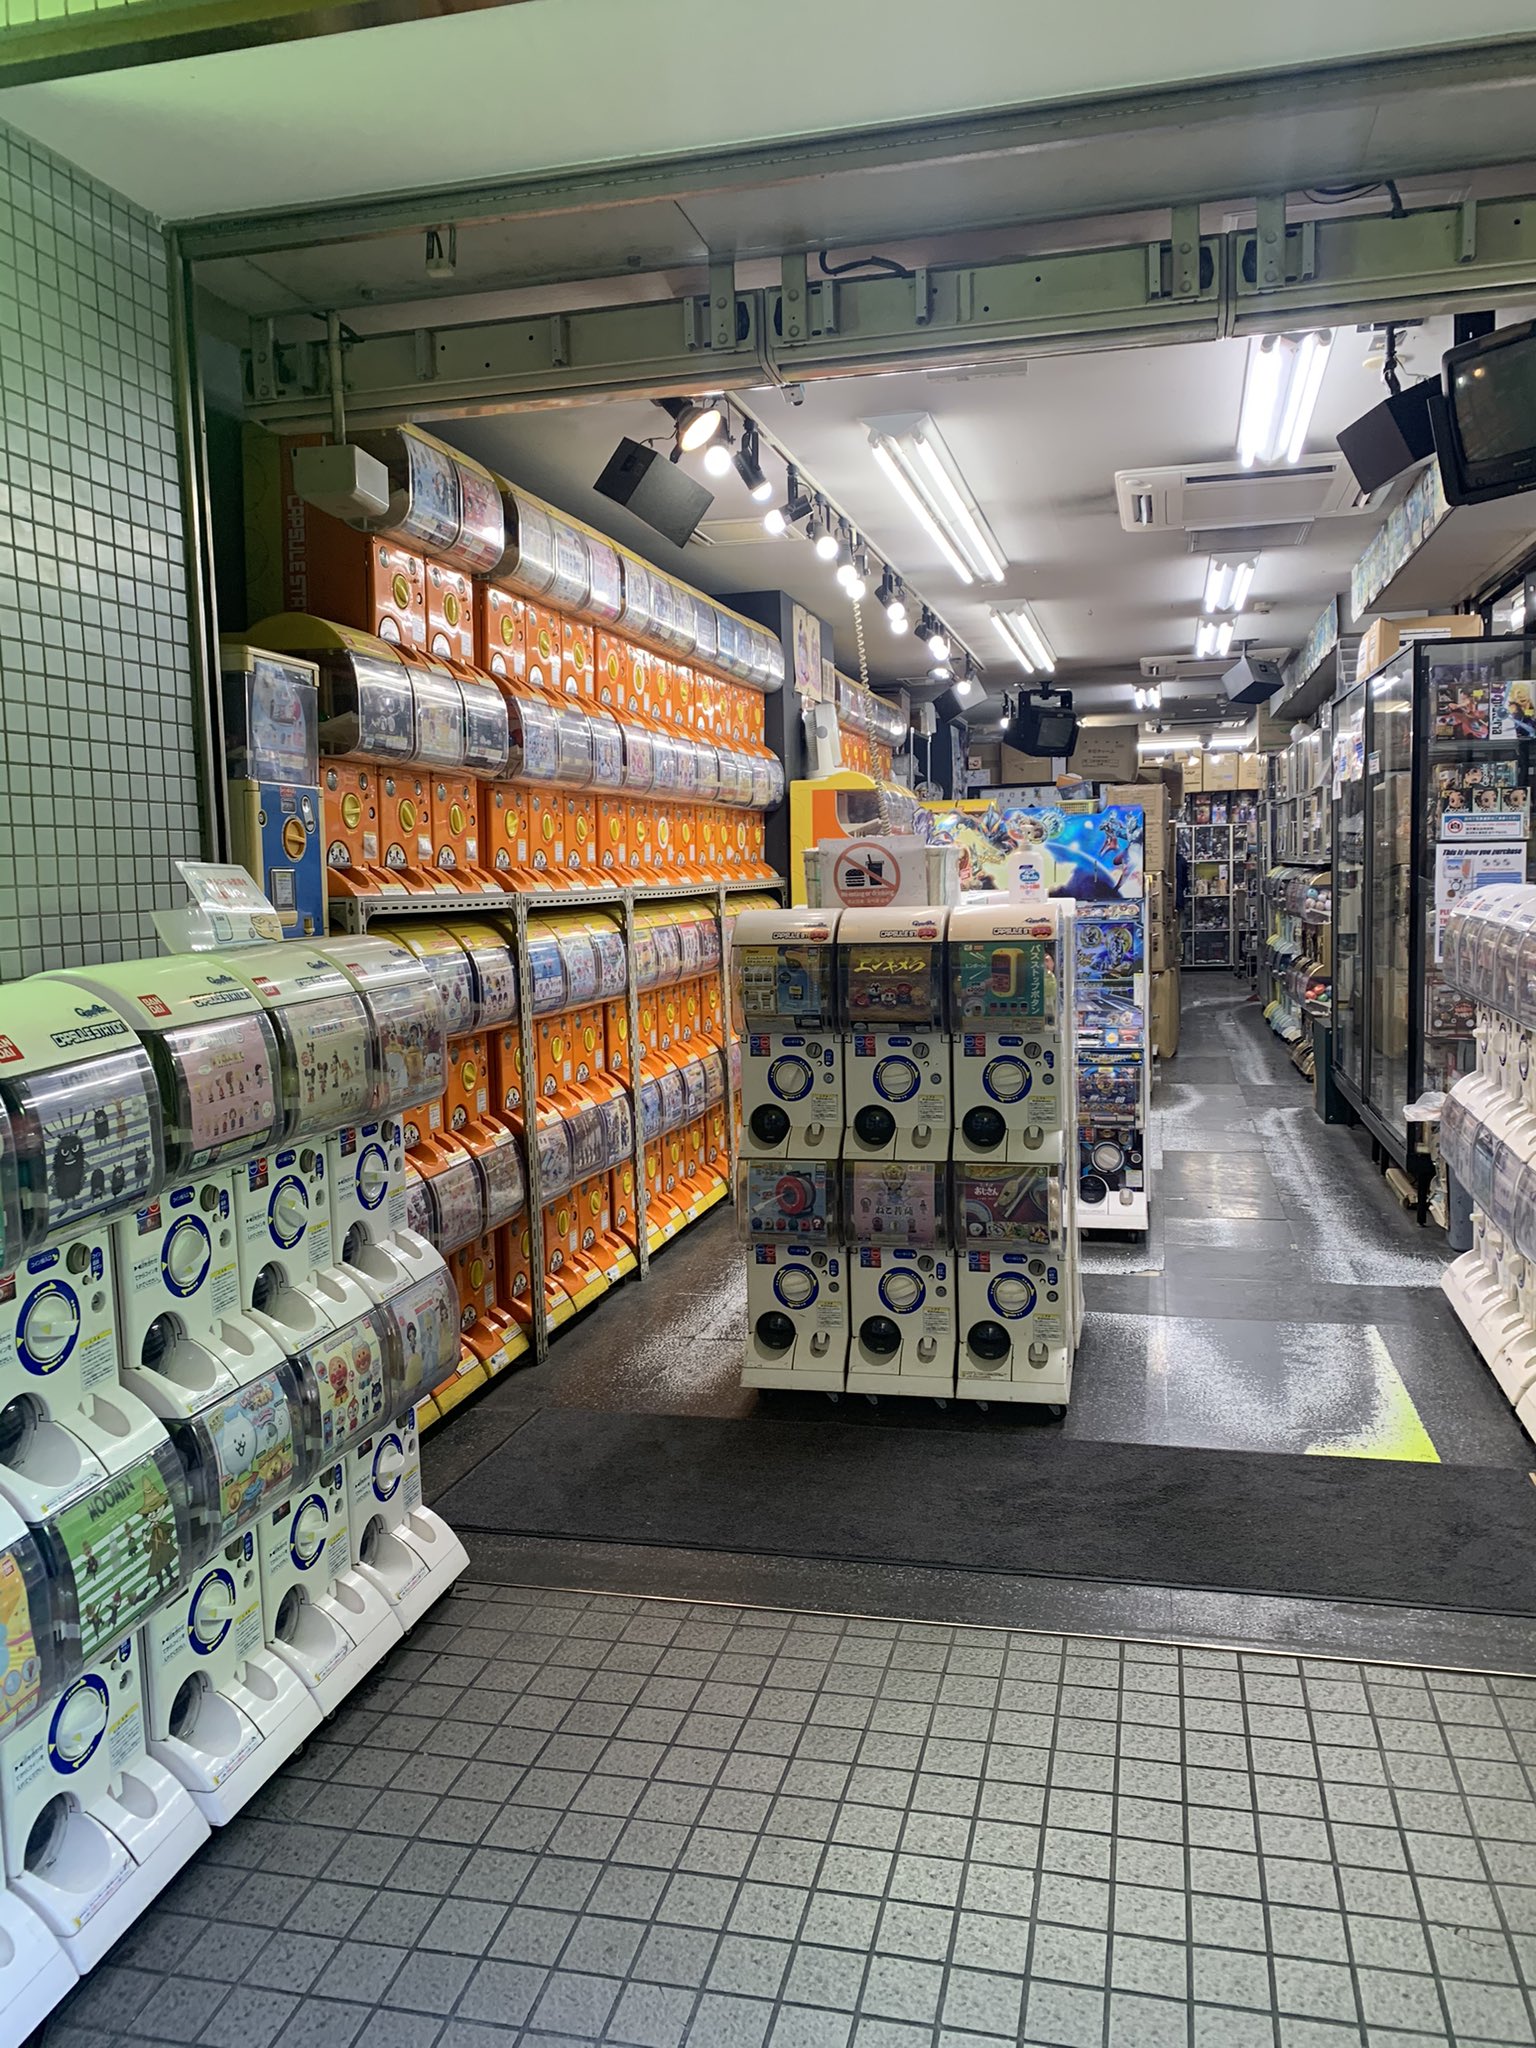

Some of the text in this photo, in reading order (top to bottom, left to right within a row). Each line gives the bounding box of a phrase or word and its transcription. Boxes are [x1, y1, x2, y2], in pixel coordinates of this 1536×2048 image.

[1491, 848, 1522, 856] purchase
[1030, 944, 1042, 1015] バスストップボタン
[50, 1019, 129, 1048] CAPSULE STATION
[87, 1474, 135, 1522] MOOMIN
